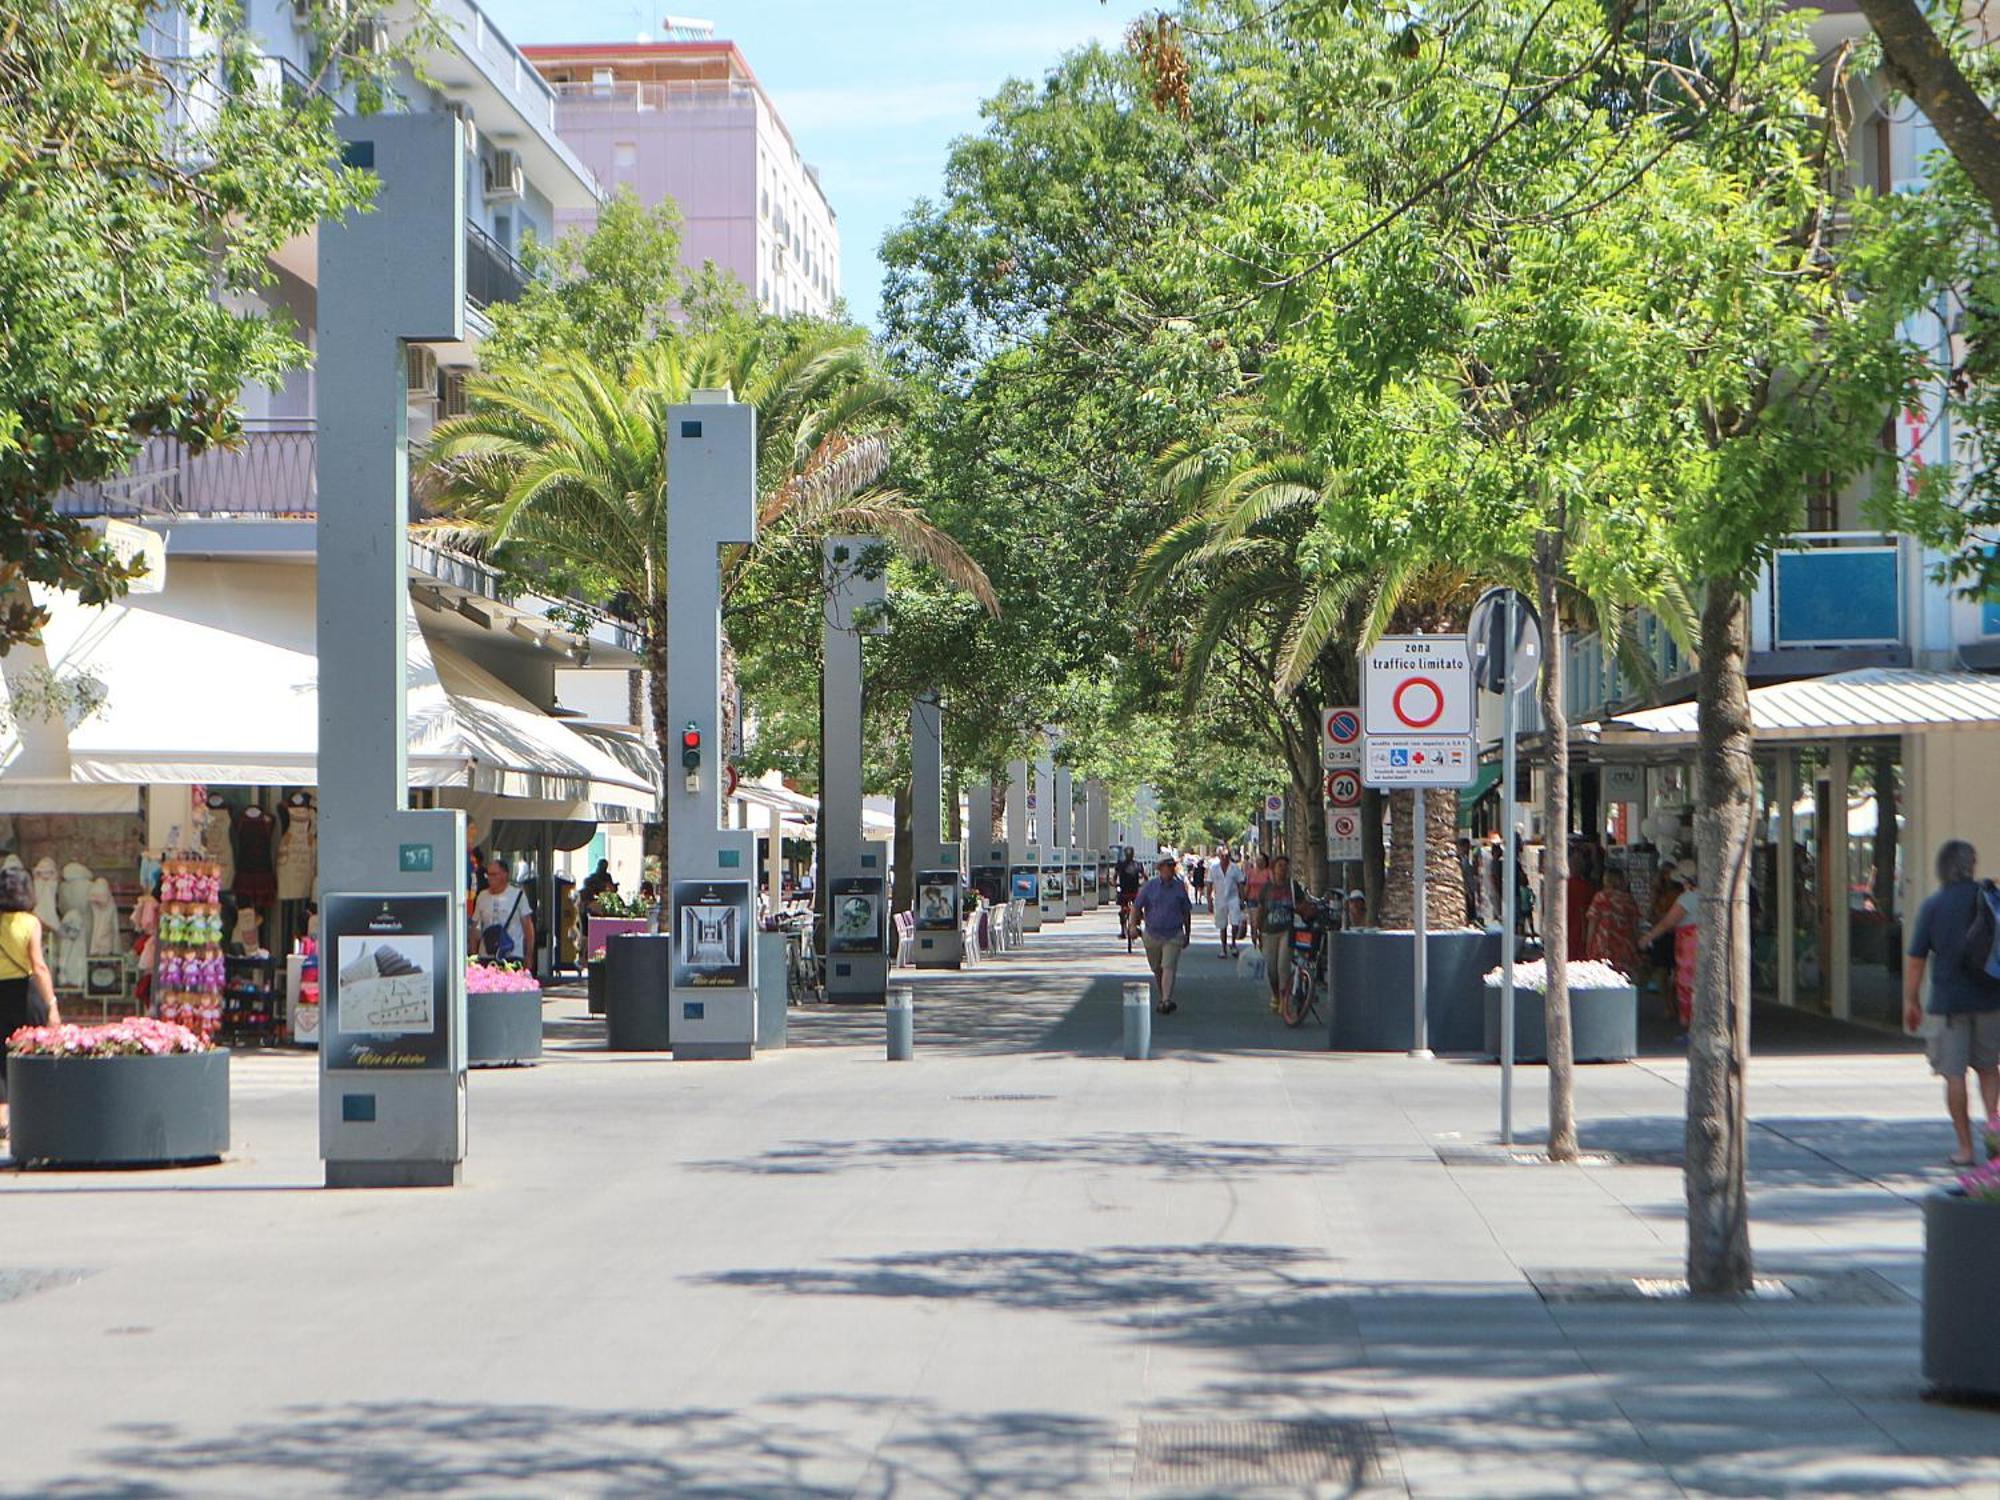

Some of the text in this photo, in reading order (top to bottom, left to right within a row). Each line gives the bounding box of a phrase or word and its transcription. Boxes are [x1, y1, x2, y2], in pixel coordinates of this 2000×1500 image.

[1405, 643, 1431, 653] zona
[1373, 658, 1464, 669] traffico limitato
[1336, 781, 1354, 796] 20
